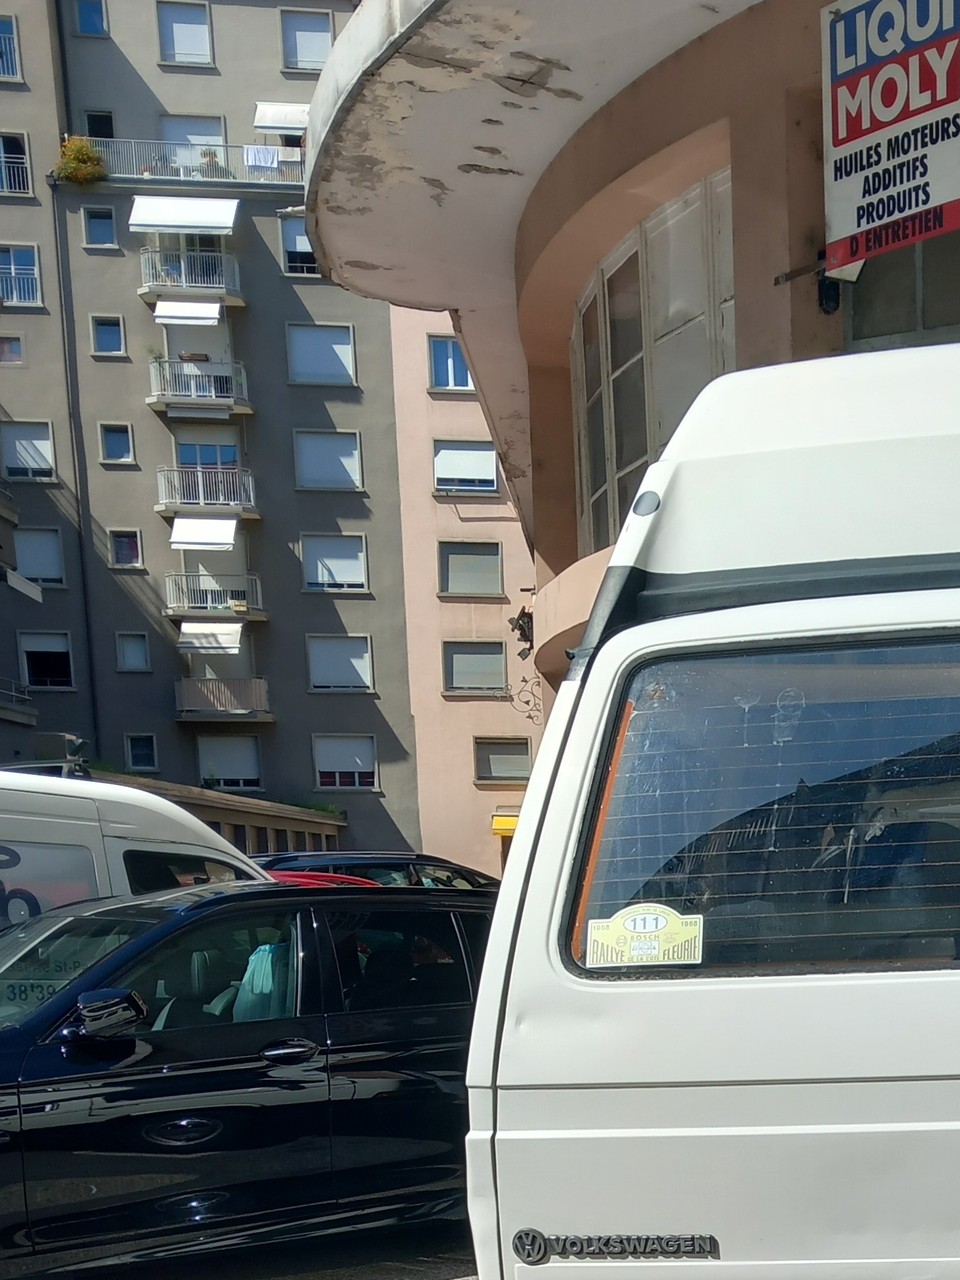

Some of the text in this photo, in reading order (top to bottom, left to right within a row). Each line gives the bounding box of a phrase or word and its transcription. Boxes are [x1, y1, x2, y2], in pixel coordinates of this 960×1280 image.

[836, 0, 955, 76] LIQUI
[837, 38, 959, 140] MOLY
[833, 112, 960, 181] HUILES MOTEURS
[862, 153, 928, 199] ADDITIFS
[856, 181, 930, 228] PRODUITS
[631, 916, 660, 930] 111
[592, 939, 625, 964] RALLYE
[663, 935, 698, 961] FLEURIE
[7, 984, 28, 1001] 38
[547, 1234, 714, 1257] VOLKSWAGEN
